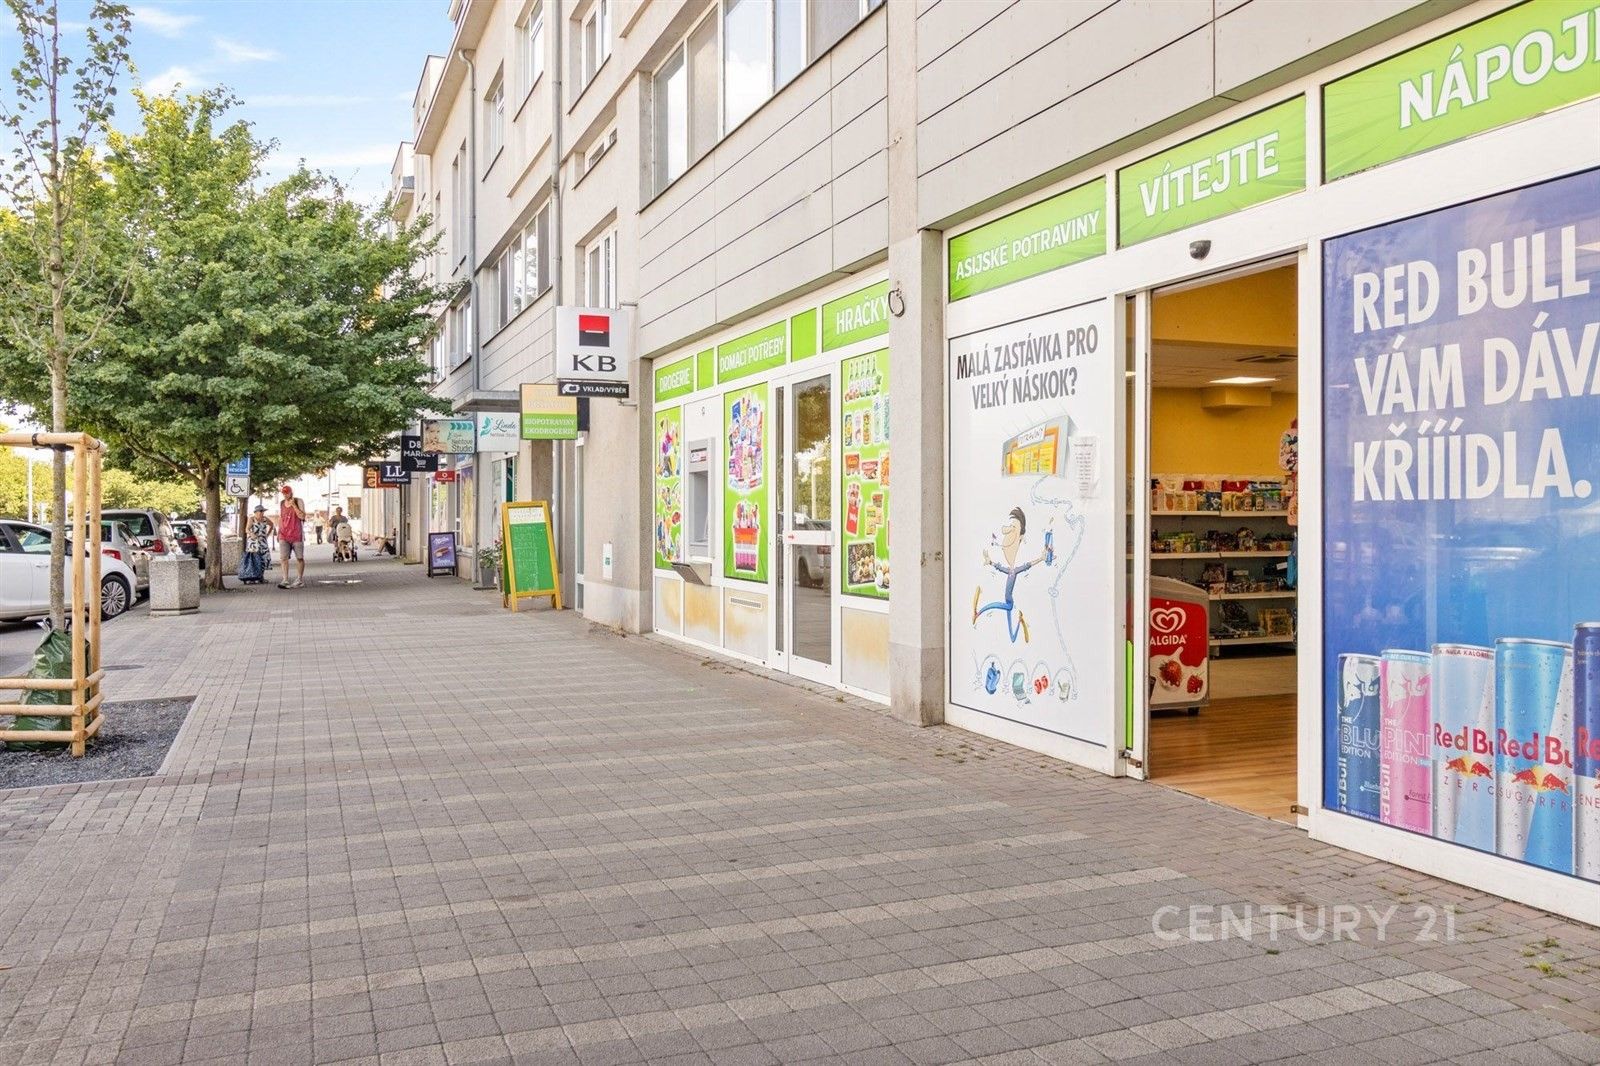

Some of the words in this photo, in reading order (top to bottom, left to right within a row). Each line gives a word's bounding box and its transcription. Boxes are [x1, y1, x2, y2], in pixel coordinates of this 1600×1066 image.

[1399, 6, 1600, 130] NÁPOJ
[1138, 131, 1279, 218] VÍTEJTE
[955, 242, 1008, 282] ASIJSKÉ
[1012, 210, 1101, 267] POTRAVINY
[1353, 260, 1440, 334] RED
[1457, 225, 1590, 316] BULL
[836, 295, 889, 335] HRAČKY
[572, 354, 617, 372] KB
[719, 346, 748, 373] DOMÁCÍ
[749, 335, 785, 362] POTŘEBY
[957, 343, 991, 380] MALÁ
[994, 332, 1062, 373] ZASTÁVKA
[1066, 324, 1098, 358] PRO
[1355, 335, 1465, 417] VÁM
[1484, 311, 1600, 406] DÁV
[659, 367, 691, 393] DROGERIE
[972, 374, 1009, 410] VELKÝ
[1012, 366, 1078, 404] NÁSKOK?
[1354, 417, 1592, 502] KŘÍÍÍDLA.
[1150, 635, 1186, 646] ALGIDA
[1434, 723, 1468, 751] Red
[1497, 729, 1539, 761] Red
